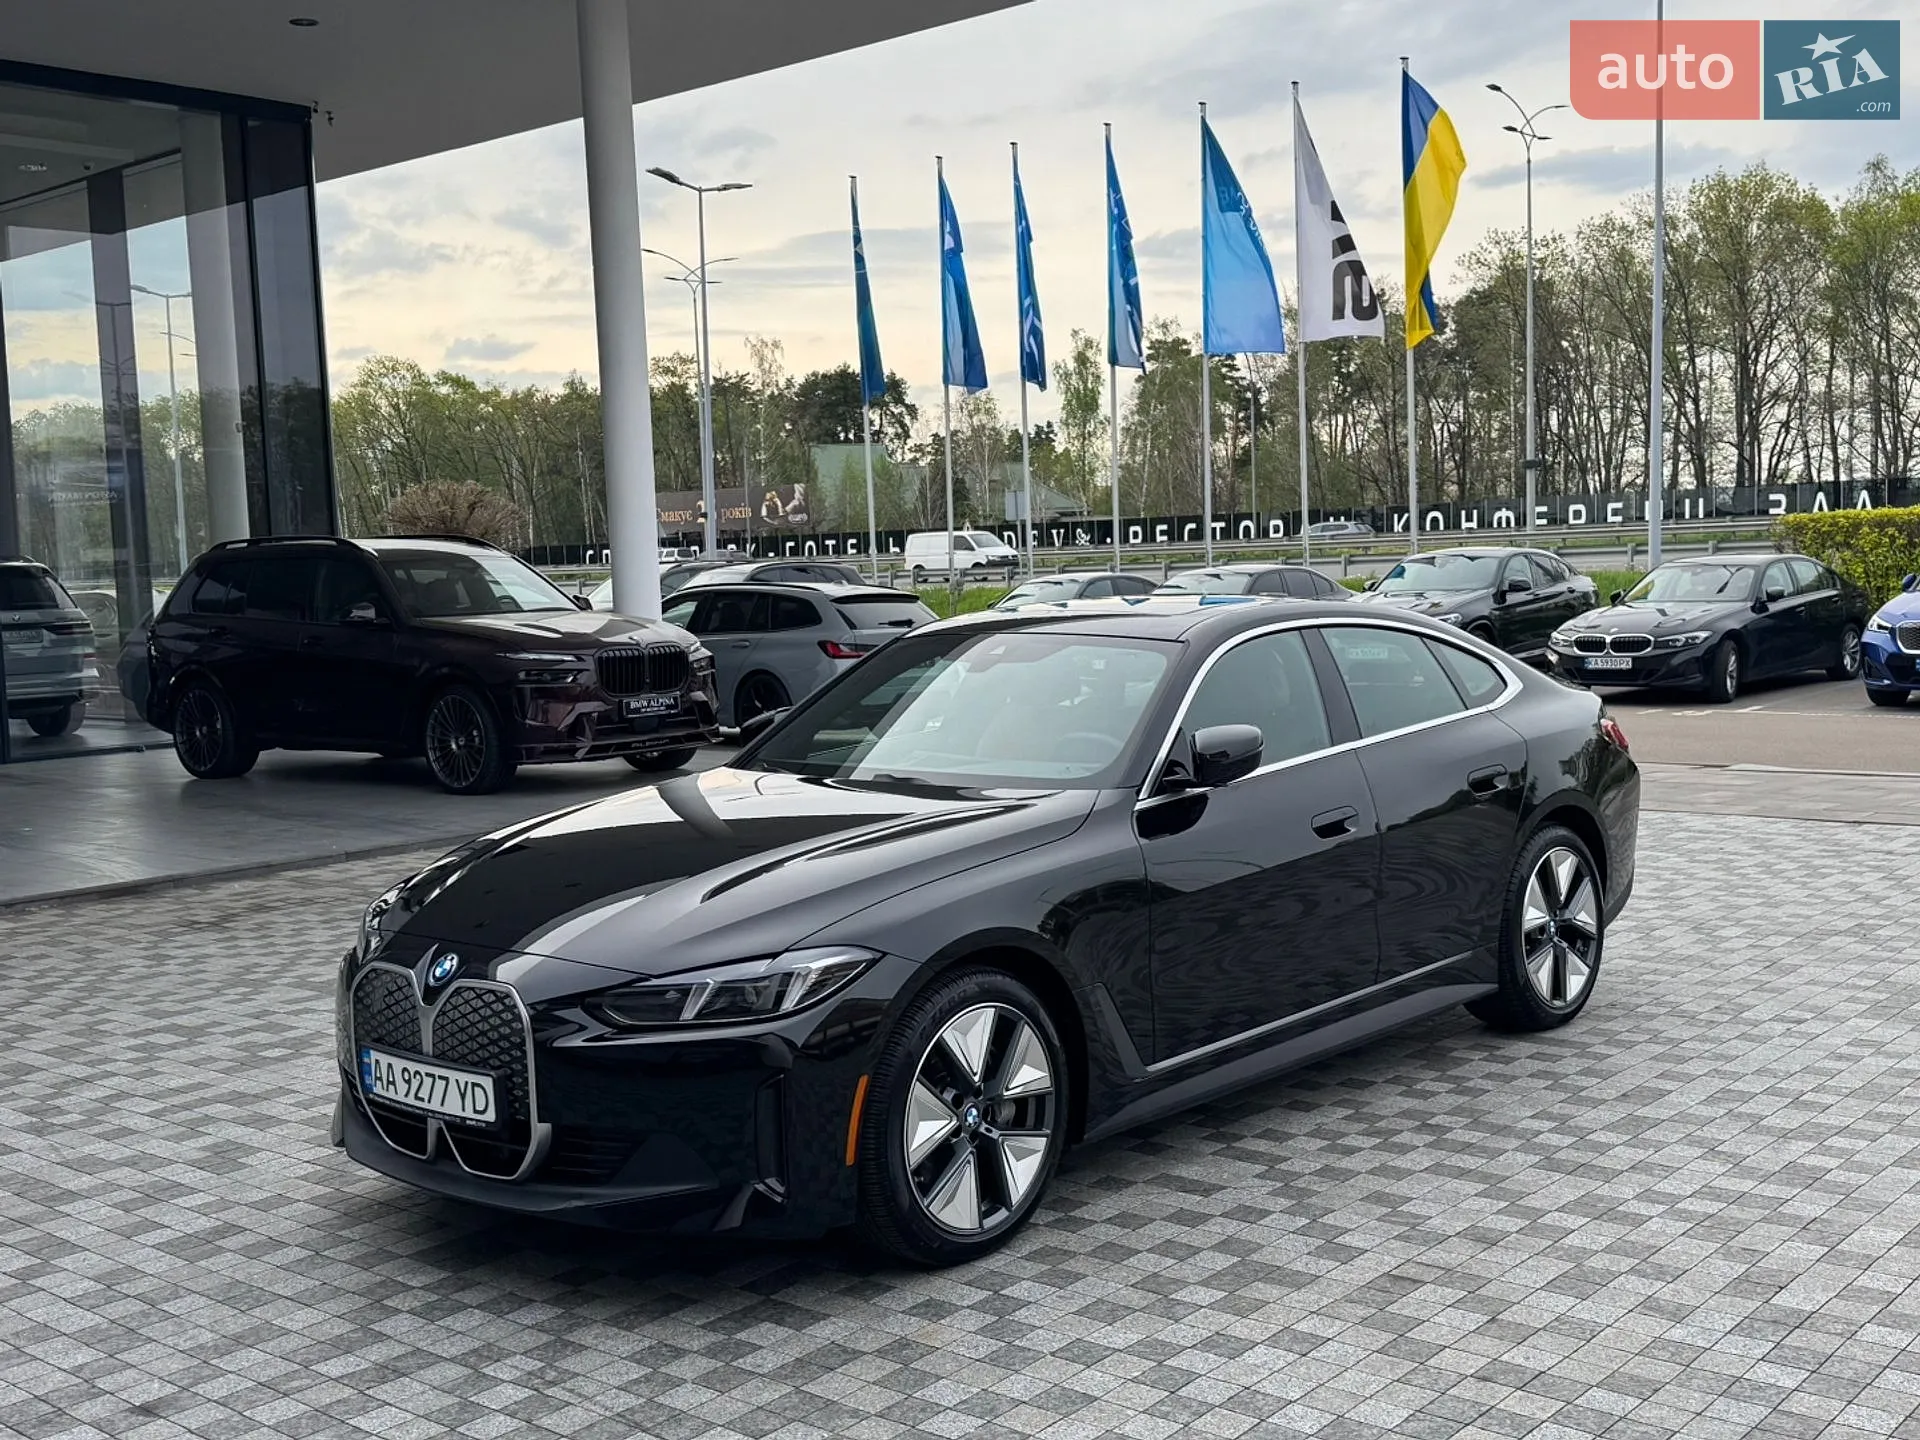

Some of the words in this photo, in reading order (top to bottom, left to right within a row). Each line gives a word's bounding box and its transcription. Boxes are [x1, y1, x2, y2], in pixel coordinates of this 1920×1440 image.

[721, 502, 752, 523] років
[1129, 516, 1345, 544] РЕСТОР
[630, 699, 649, 709] BMW
[650, 697, 675, 707] ALPINA
[374, 1058, 398, 1096] AA
[401, 1067, 450, 1107] 9277
[456, 1079, 489, 1116] YD
